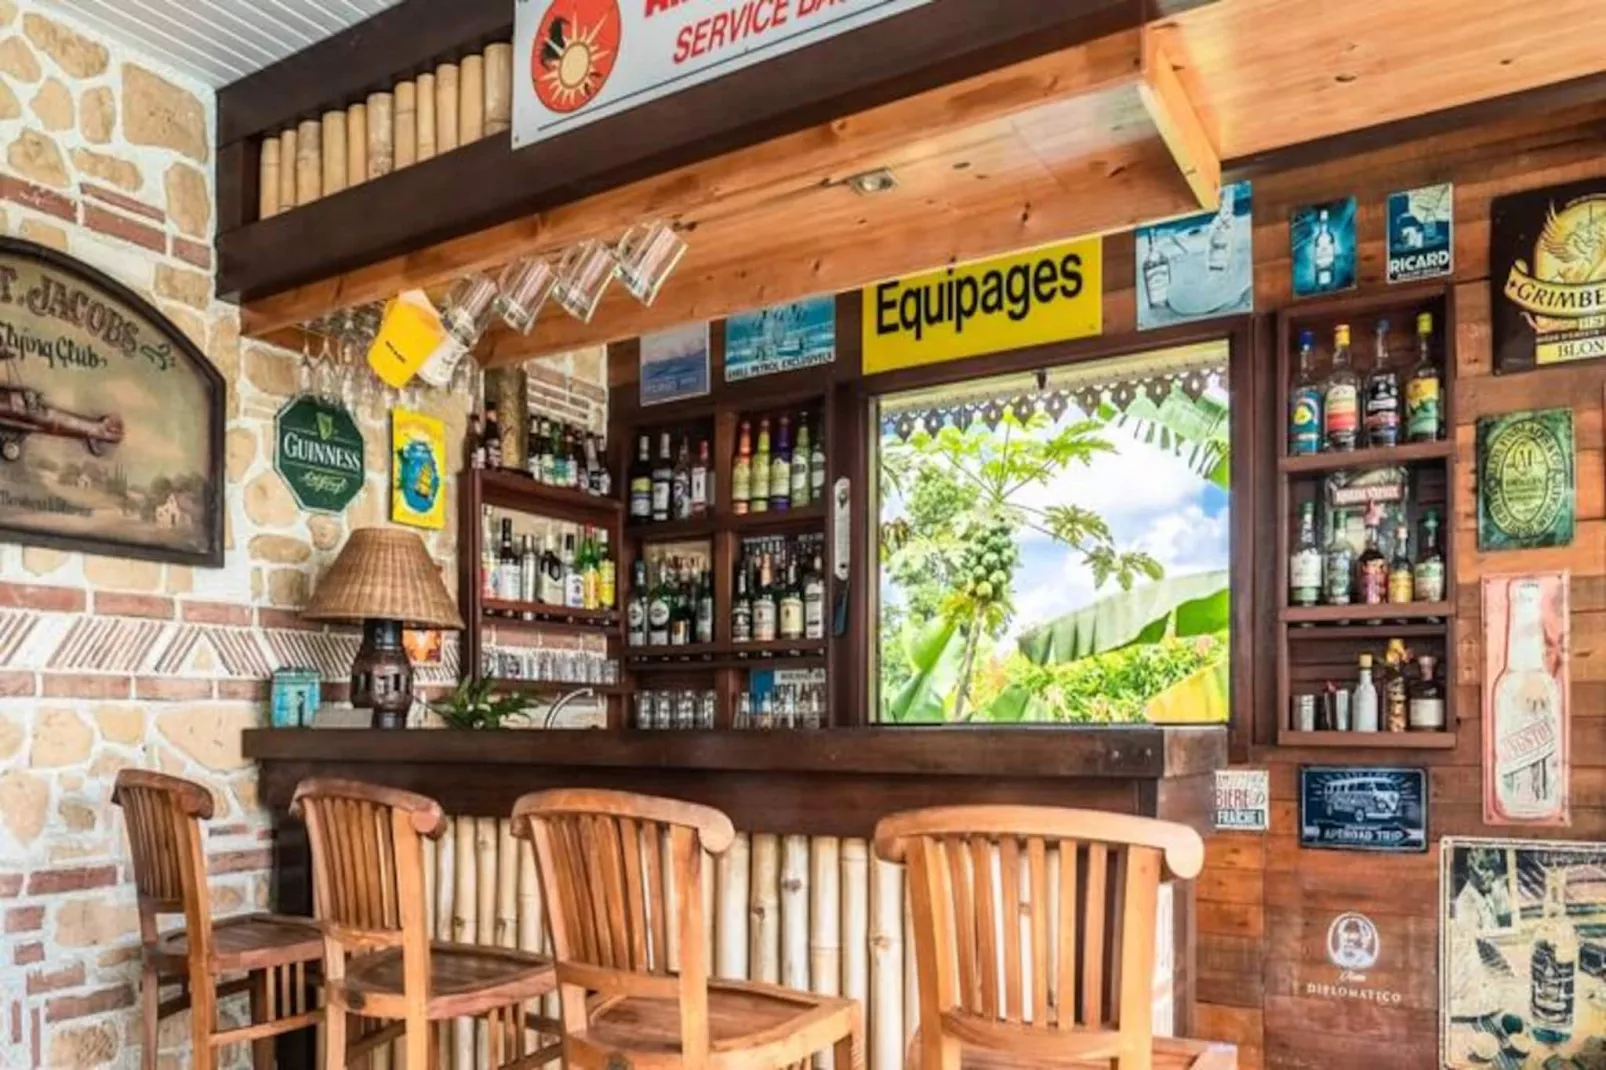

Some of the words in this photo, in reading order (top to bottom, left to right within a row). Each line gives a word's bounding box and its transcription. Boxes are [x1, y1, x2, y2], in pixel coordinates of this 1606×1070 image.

[673, 0, 789, 64] SERVICE
[1390, 250, 1449, 274] RICARD
[876, 253, 1083, 340] Equipages
[1517, 282, 1606, 308] GRIMBE
[27, 275, 139, 358] JACOBS
[56, 336, 99, 368] Club
[284, 431, 361, 472] GUINNESS
[1307, 982, 1401, 1004] DIPLOMATICO
